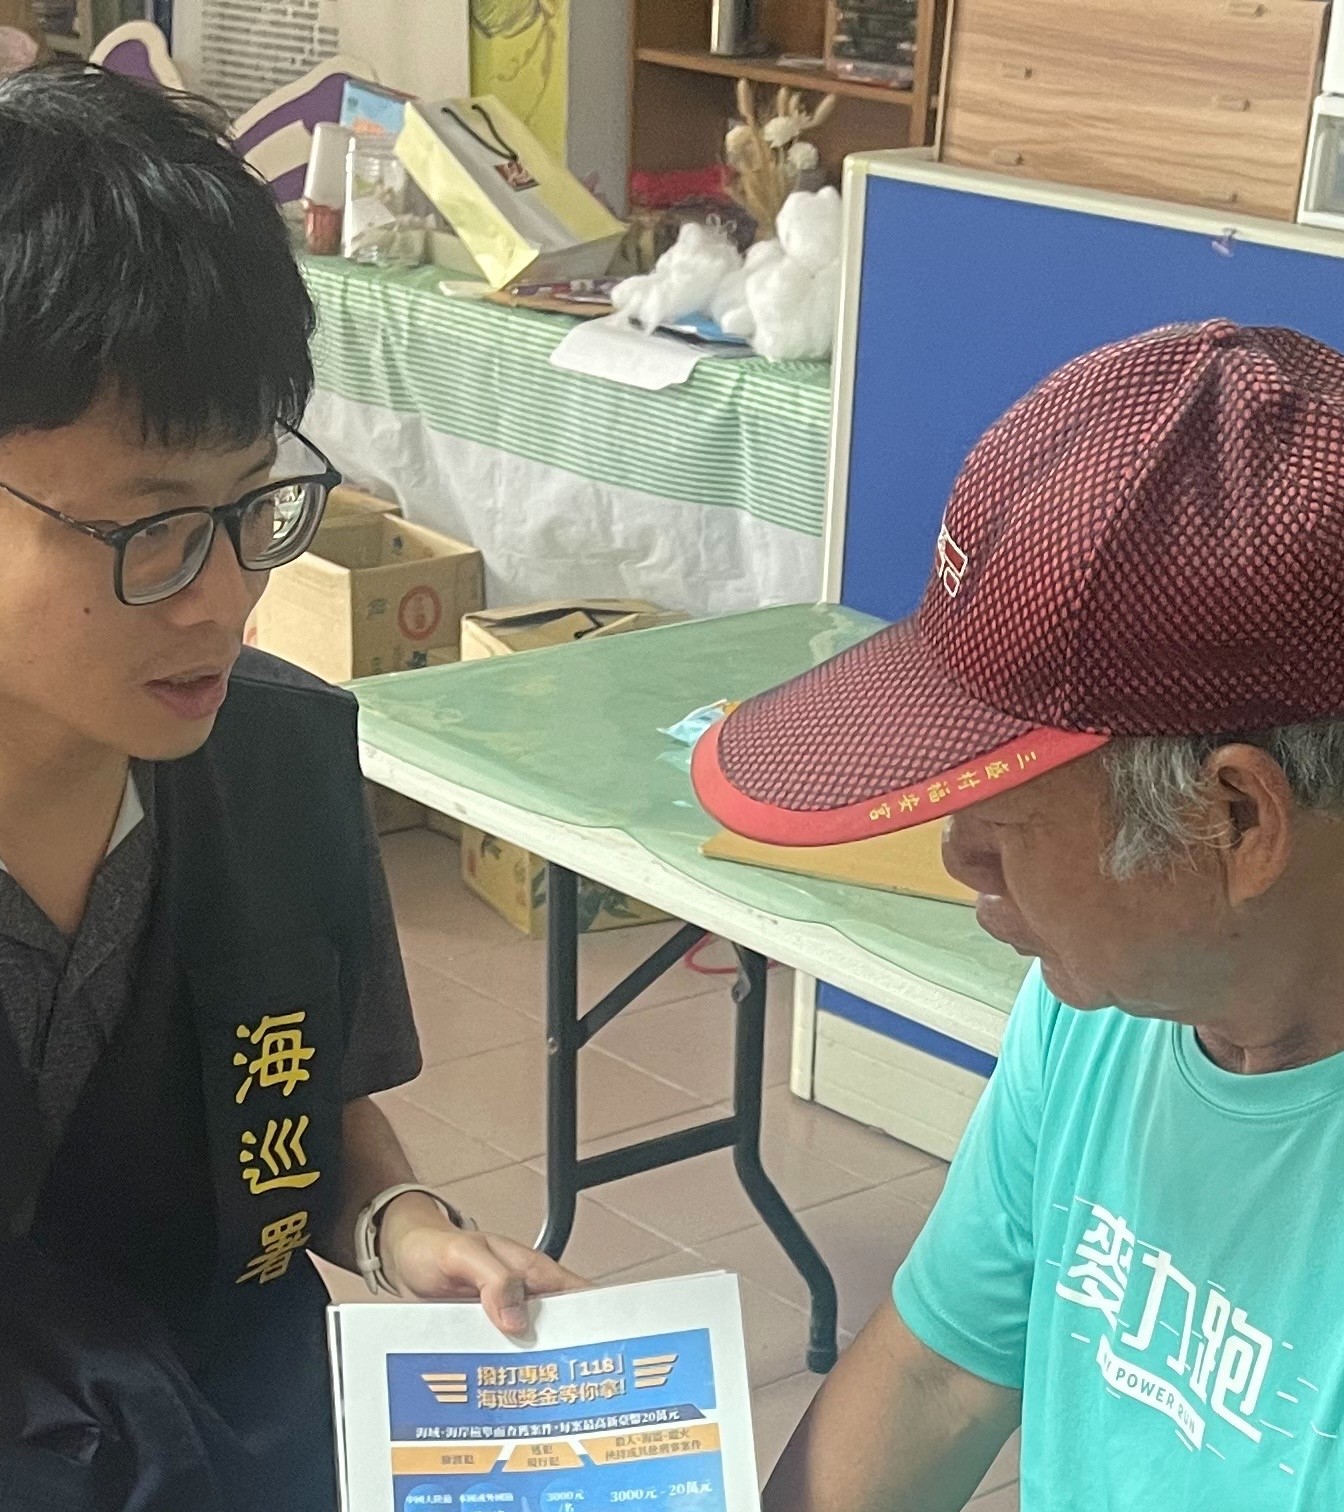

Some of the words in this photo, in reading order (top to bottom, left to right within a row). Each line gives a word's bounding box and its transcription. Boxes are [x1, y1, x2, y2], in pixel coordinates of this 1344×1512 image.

[233, 1011, 321, 1284] 海巡署
[1056, 1204, 1273, 1443] 麥力跑
[1115, 1367, 1175, 1409] POWER
[1177, 1403, 1196, 1435] RUN
